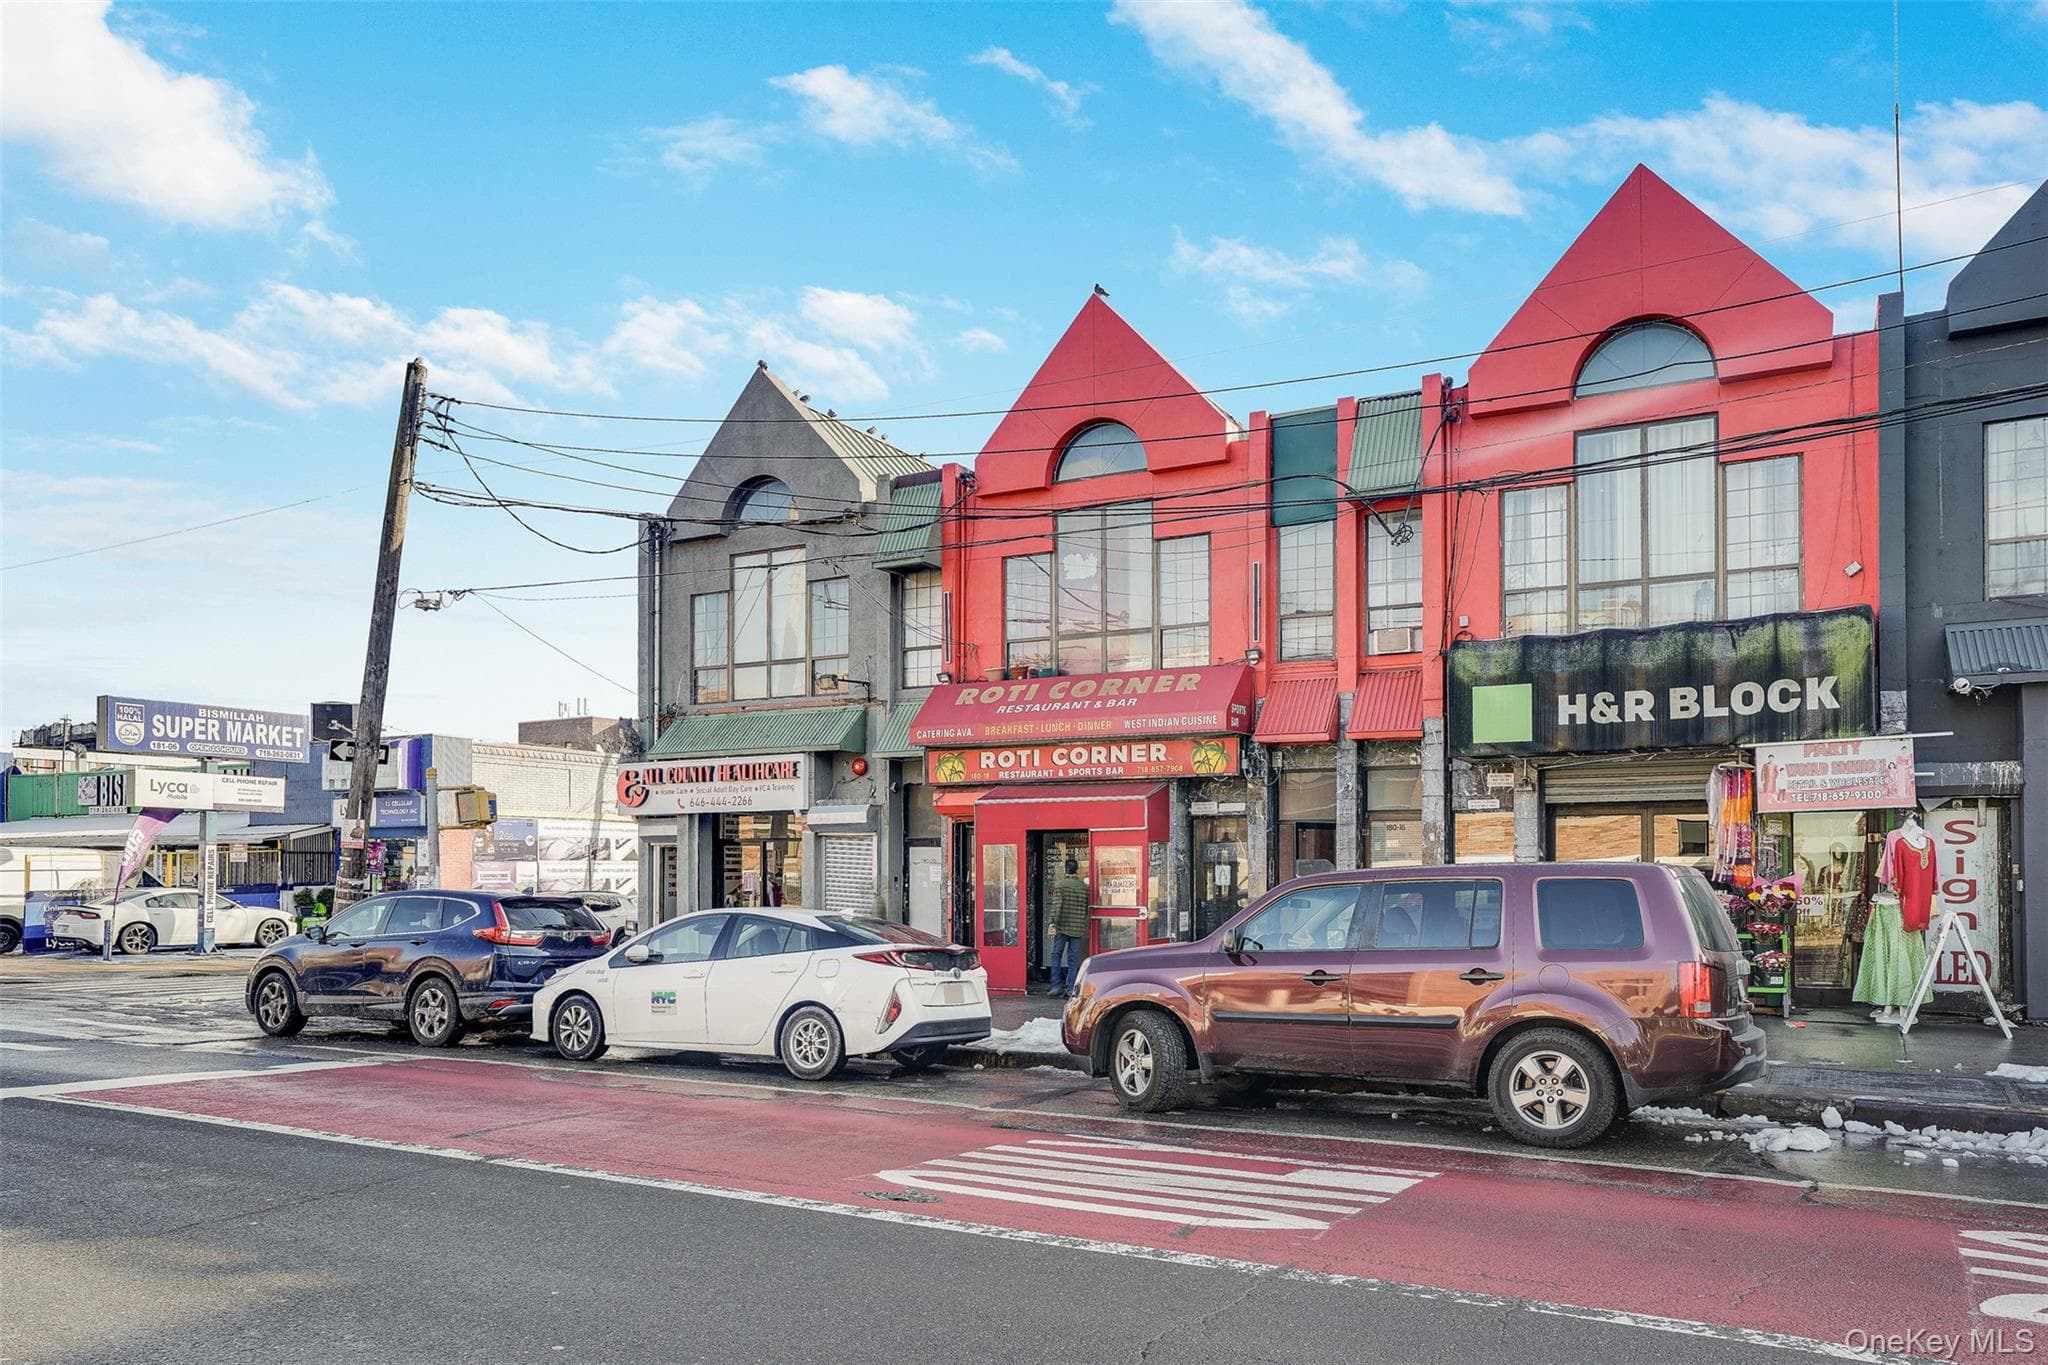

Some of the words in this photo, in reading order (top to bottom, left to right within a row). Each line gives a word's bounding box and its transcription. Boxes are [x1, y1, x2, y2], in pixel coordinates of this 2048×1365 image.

[955, 684, 1040, 705] ROTI
[1049, 673, 1201, 699] CORNER
[996, 700, 1091, 714] RESTAURANT
[1093, 700, 1103, 709] &
[1106, 698, 1137, 708] BAR
[1557, 689, 1655, 726] H&R
[1669, 676, 1840, 720] BLOCK
[117, 713, 143, 721] HALAL
[119, 706, 141, 715] 100%
[199, 709, 264, 723] BISMILLAH
[152, 715, 220, 741] SUPER
[226, 720, 304, 748] MARKET
[916, 729, 955, 739] CATERING
[957, 727, 974, 737] AVA.
[985, 724, 1034, 736] BREAKFAST
[1040, 722, 1071, 733] LUNCH
[1077, 720, 1112, 731] DINNER
[1123, 718, 1146, 729] WEST
[1148, 717, 1181, 728] INDIAN
[1182, 714, 1218, 726] CUISINE
[152, 742, 178, 750] 181-06
[1803, 740, 1863, 758] PARTY
[980, 749, 1040, 769] ROTI
[1052, 743, 1168, 766] CORNER
[643, 767, 666, 784] ALL
[666, 765, 715, 784] COUNTY
[717, 760, 800, 782] HEALTHCARE
[999, 769, 1054, 779] RESTAURANT
[1057, 769, 1064, 777] &
[1068, 768, 1103, 777] SPORTS
[1106, 767, 1124, 775] BAR
[1785, 761, 1829, 777] WORLD
[150, 779, 188, 797] Lyca
[772, 783, 795, 792] Training
[1787, 779, 1818, 790] RETAIL
[1820, 778, 1828, 788] &
[1829, 775, 1886, 787] WHOLESALE
[689, 795, 753, 808] 646-444-2266
[207, 848, 215, 879] REPAIRS
[1942, 820, 1977, 930] Sign
[206, 880, 214, 905] PHONE
[206, 906, 214, 923] CELL
[1934, 950, 1992, 986] LED
[651, 991, 676, 1004] NYC
